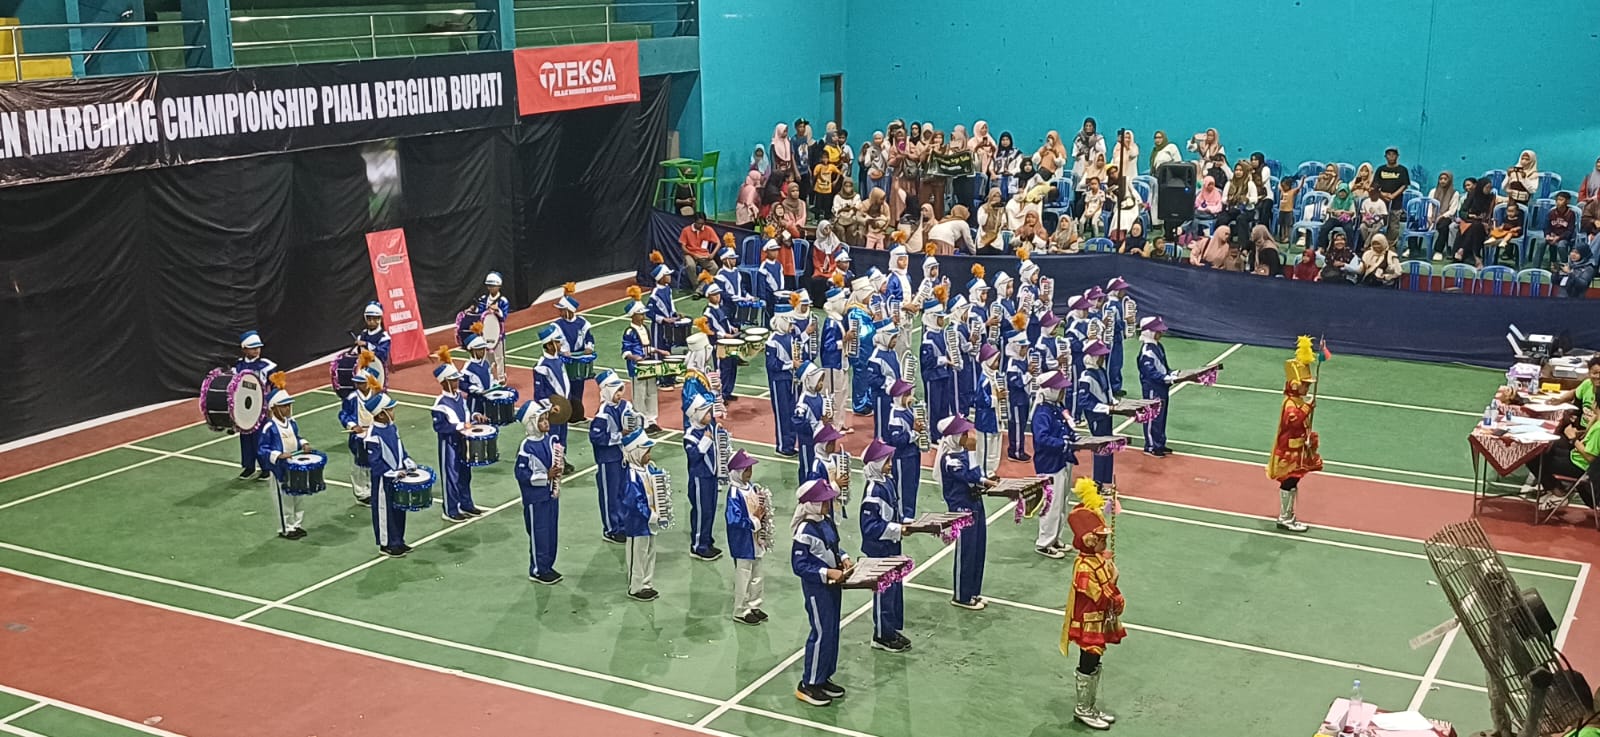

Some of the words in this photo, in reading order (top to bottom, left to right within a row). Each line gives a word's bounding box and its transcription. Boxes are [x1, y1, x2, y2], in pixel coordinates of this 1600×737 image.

[554, 58, 616, 87] TEKSA
[0, 111, 23, 159] N
[25, 99, 159, 156] MARCHING
[161, 87, 317, 141] CHAMPIONSHIP
[322, 82, 373, 125] PIALA
[374, 76, 449, 120] BERGILIR
[450, 71, 502, 111] BUPATI
